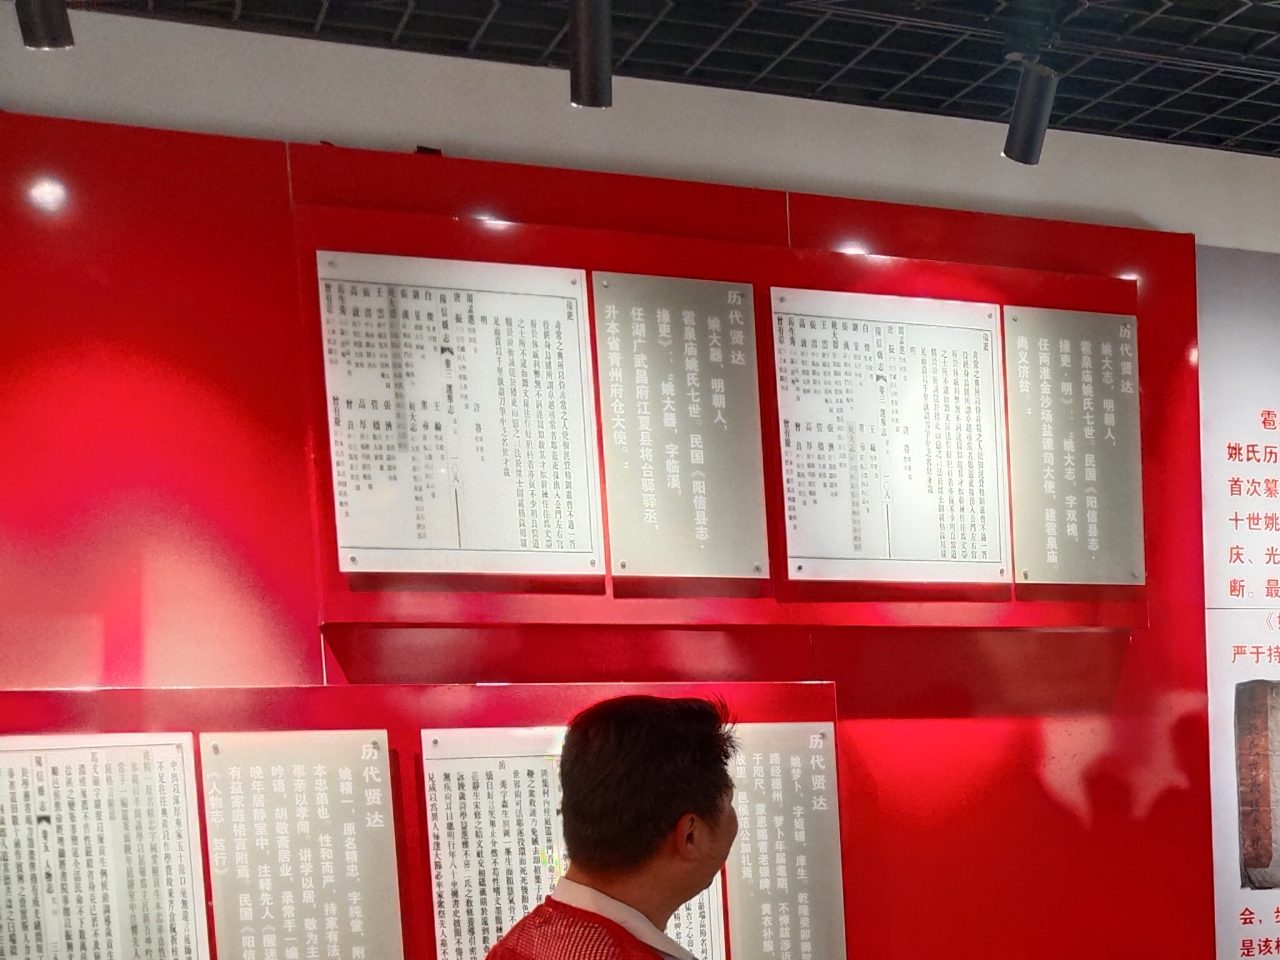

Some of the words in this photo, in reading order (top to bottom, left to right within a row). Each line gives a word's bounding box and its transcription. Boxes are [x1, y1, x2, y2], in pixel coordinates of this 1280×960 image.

[727, 289, 747, 366] 历代贤达
[1119, 324, 1135, 394] 历代贤达
[361, 743, 385, 828] 历代贤达
[809, 734, 828, 810] 历代贤达
